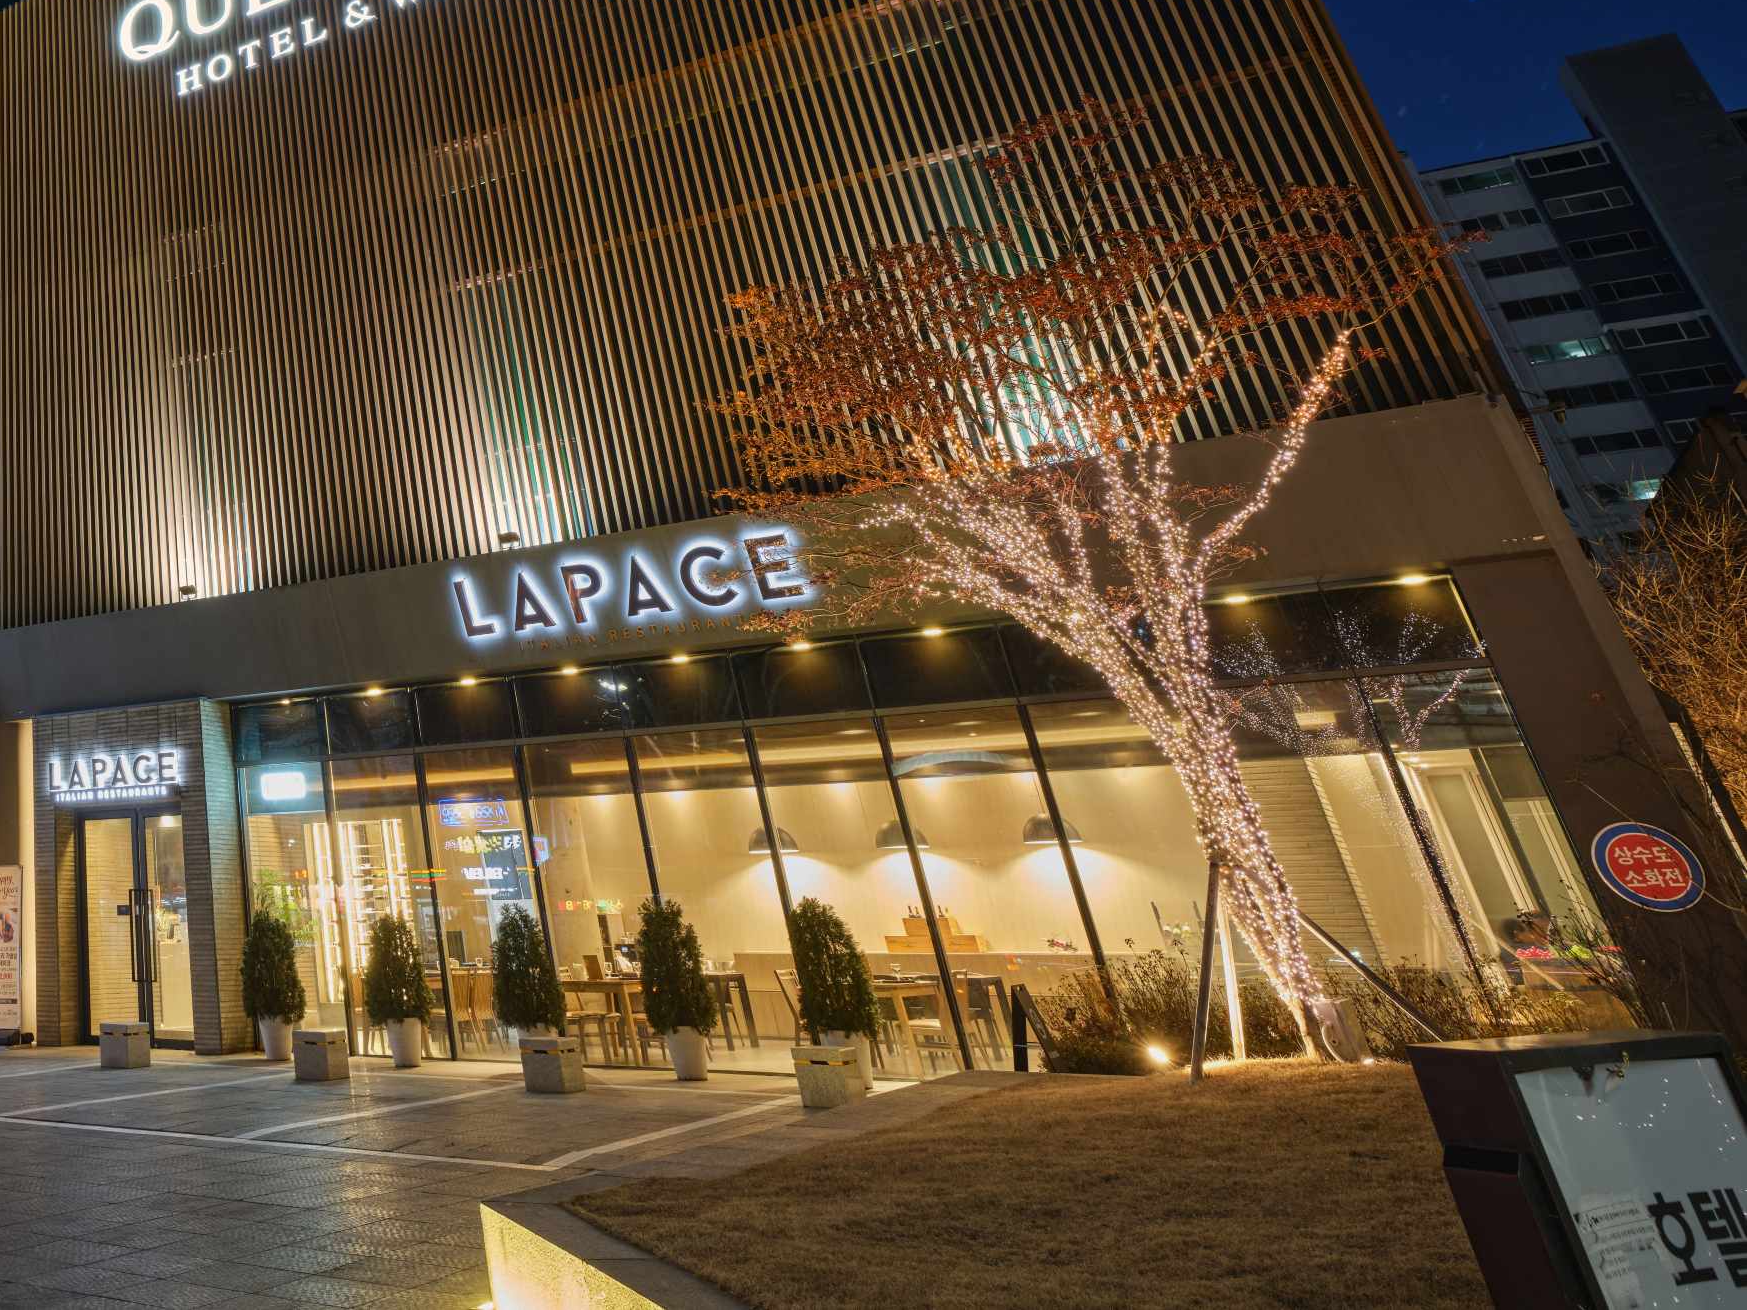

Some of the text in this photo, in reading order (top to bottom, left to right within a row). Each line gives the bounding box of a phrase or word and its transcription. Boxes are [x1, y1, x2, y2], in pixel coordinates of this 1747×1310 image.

[175, 21, 329, 97] HOTEL
[452, 532, 807, 638] LAPACE
[48, 751, 178, 791] LAPACE
[55, 792, 93, 803] ITALIAN
[1613, 845, 1671, 865] 상수도
[1625, 867, 1686, 888] 소화전
